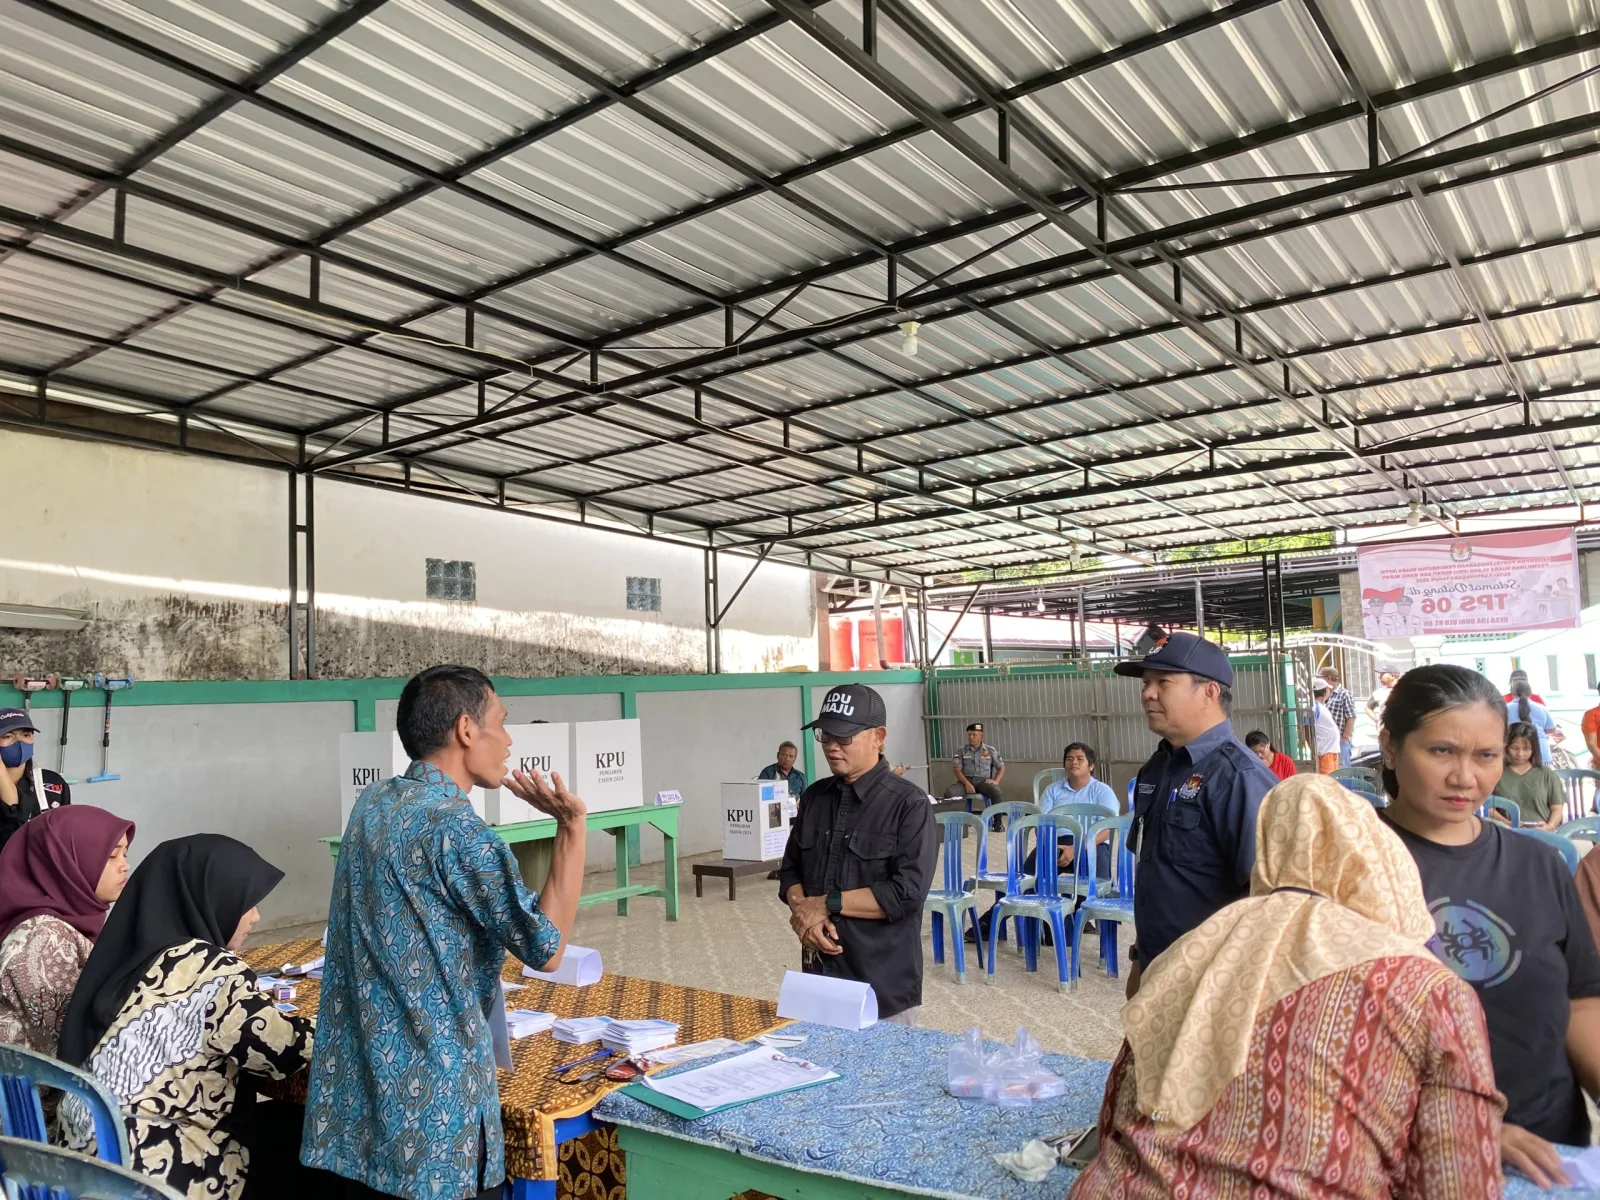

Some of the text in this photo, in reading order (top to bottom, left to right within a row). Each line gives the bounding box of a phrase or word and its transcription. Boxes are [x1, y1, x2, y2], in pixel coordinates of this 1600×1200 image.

[827, 692, 852, 705] LDU
[821, 702, 855, 716] MAJU
[519, 755, 552, 774] KPU
[595, 751, 626, 769] KPU
[352, 768, 381, 786] KPU
[727, 809, 753, 823] KPU
